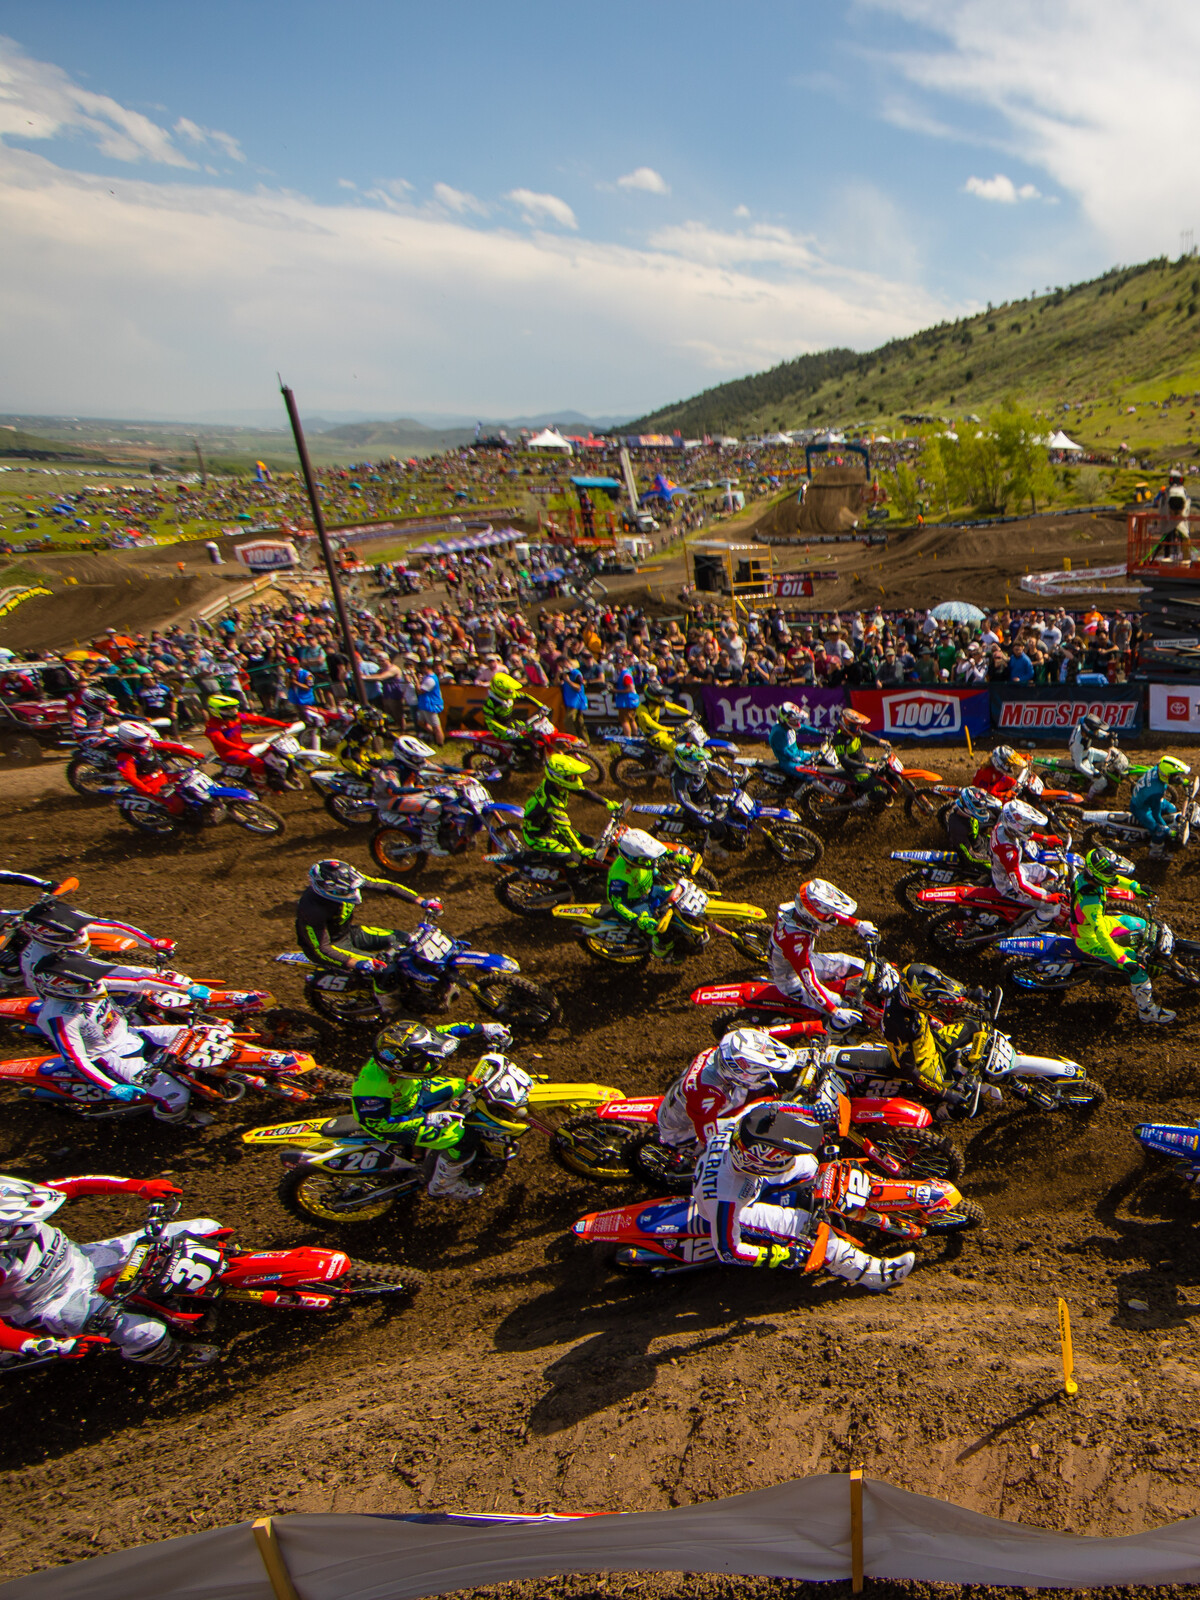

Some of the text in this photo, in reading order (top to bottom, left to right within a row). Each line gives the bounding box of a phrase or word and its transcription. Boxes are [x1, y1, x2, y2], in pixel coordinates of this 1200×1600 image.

[781, 582, 806, 595] OIL
[717, 694, 843, 732] Hooier
[895, 703, 950, 727] 100%
[930, 868, 955, 883] 156
[421, 928, 453, 962] 45
[1042, 962, 1074, 978] 34
[316, 974, 350, 991] 45
[701, 990, 740, 1000] GEICO
[185, 1028, 235, 1069] 233
[992, 1035, 1014, 1070] 36
[71, 1083, 118, 1102] 23
[500, 1063, 533, 1102] 26
[865, 1079, 902, 1097] 36
[608, 1103, 655, 1113] GEICO
[344, 1151, 381, 1171] 26
[845, 1168, 870, 1209] 12
[679, 1237, 717, 1262] 12
[171, 1238, 221, 1293] 31
